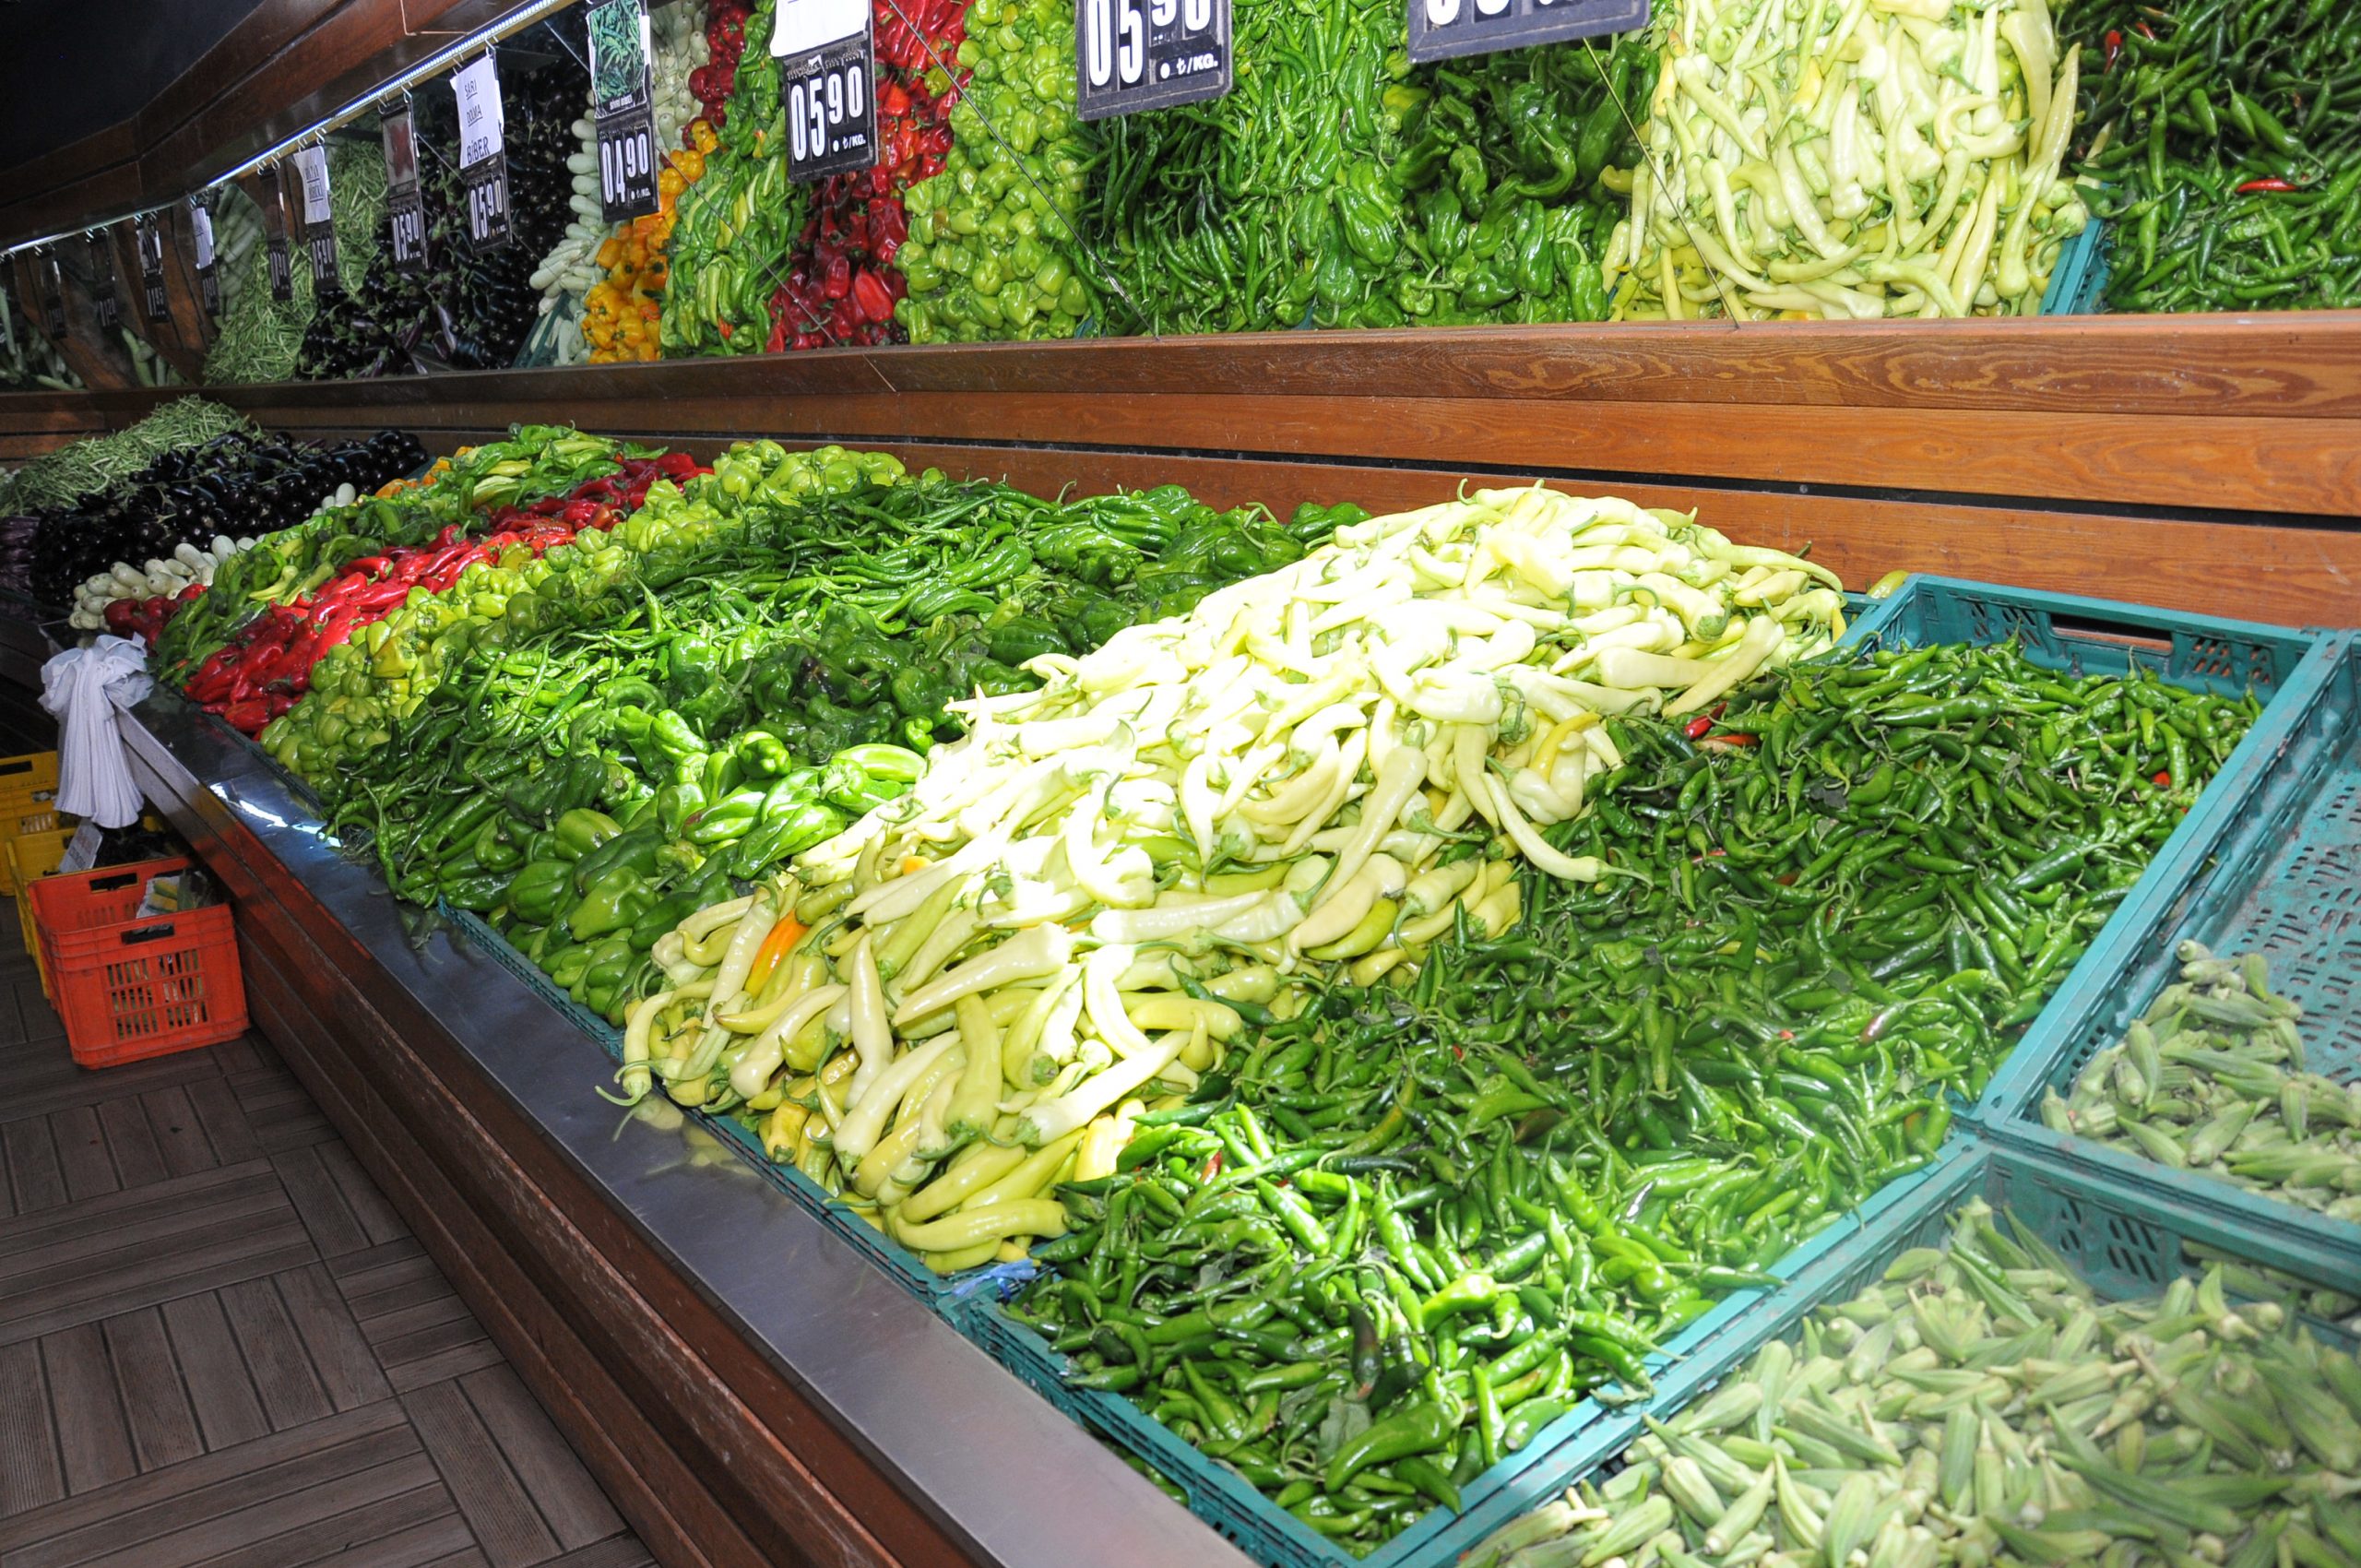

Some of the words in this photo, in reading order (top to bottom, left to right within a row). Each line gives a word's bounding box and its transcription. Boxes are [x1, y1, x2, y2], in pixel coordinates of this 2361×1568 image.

[790, 65, 864, 161] 0590
[602, 133, 649, 204] 0490
[393, 210, 420, 262] 0590
[470, 180, 504, 241] 0590
